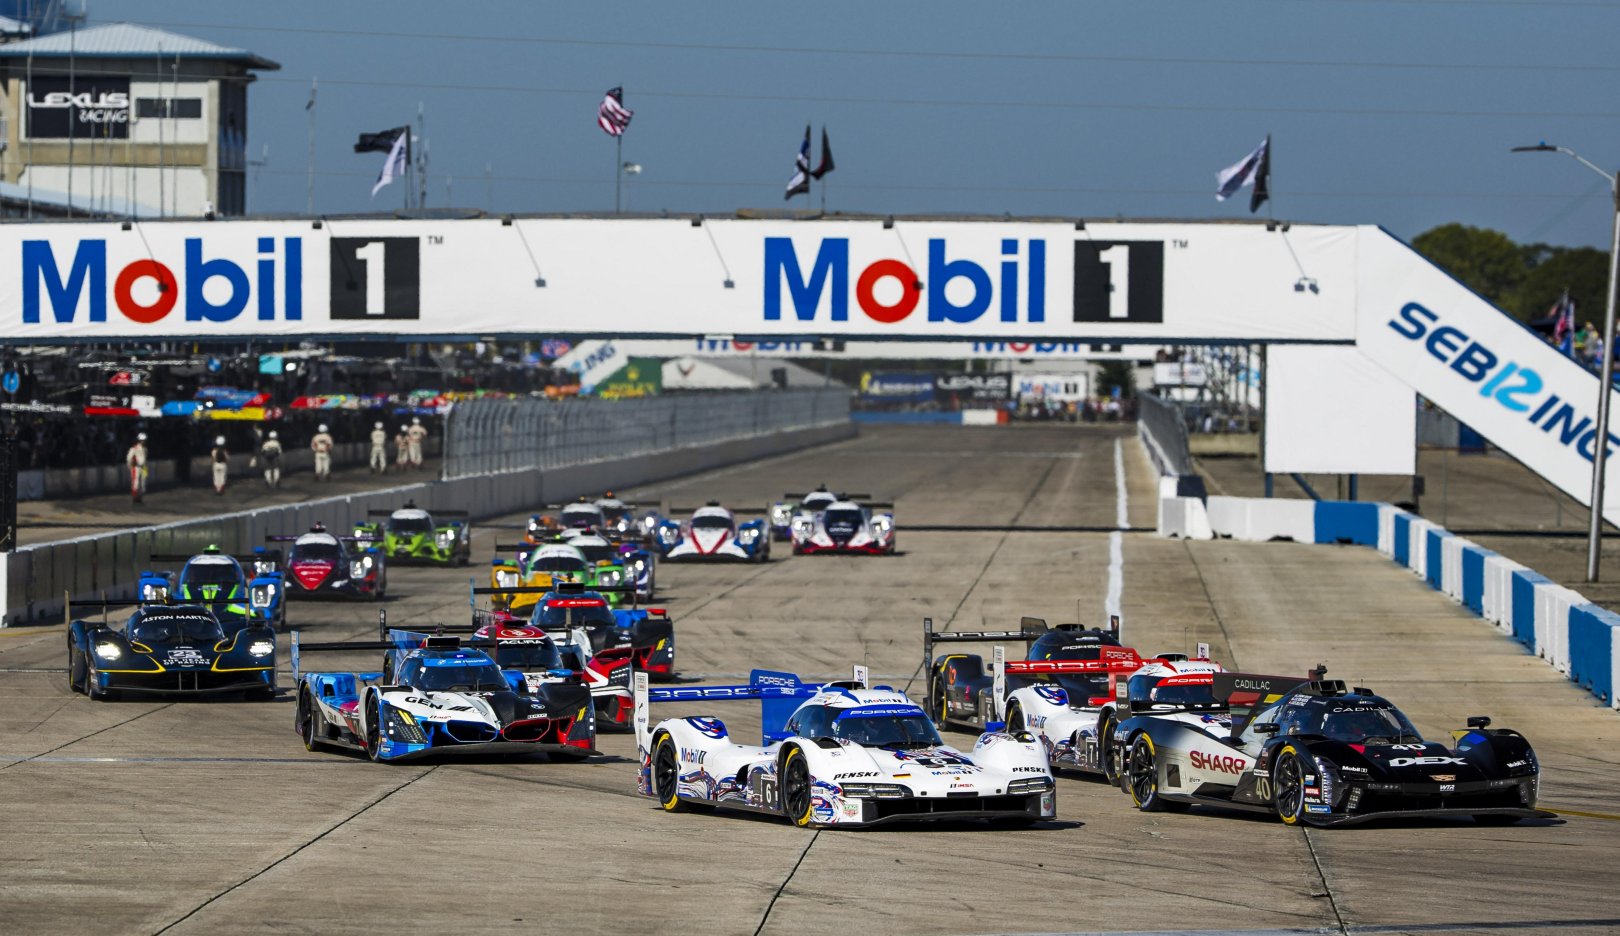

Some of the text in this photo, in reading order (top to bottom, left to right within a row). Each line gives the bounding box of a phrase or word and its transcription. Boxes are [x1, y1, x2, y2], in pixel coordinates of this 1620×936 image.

[28, 92, 129, 108] LEXUS
[79, 109, 128, 123] RACING
[22, 237, 303, 324] Mobil
[355, 241, 385, 315] 1
[764, 237, 1189, 324] Mobil 1 TM
[141, 615, 174, 624] ASTON
[758, 675, 796, 687] PORSCHE
[1234, 679, 1271, 691] CADILLAC
[405, 696, 443, 710] GEN
[681, 747, 699, 764] Mobil
[1189, 750, 1246, 775] SHARP
[1389, 756, 1469, 767] DEX
[833, 771, 881, 780] PENSKE
[765, 783, 772, 804] 6
[1255, 777, 1271, 801] 40
